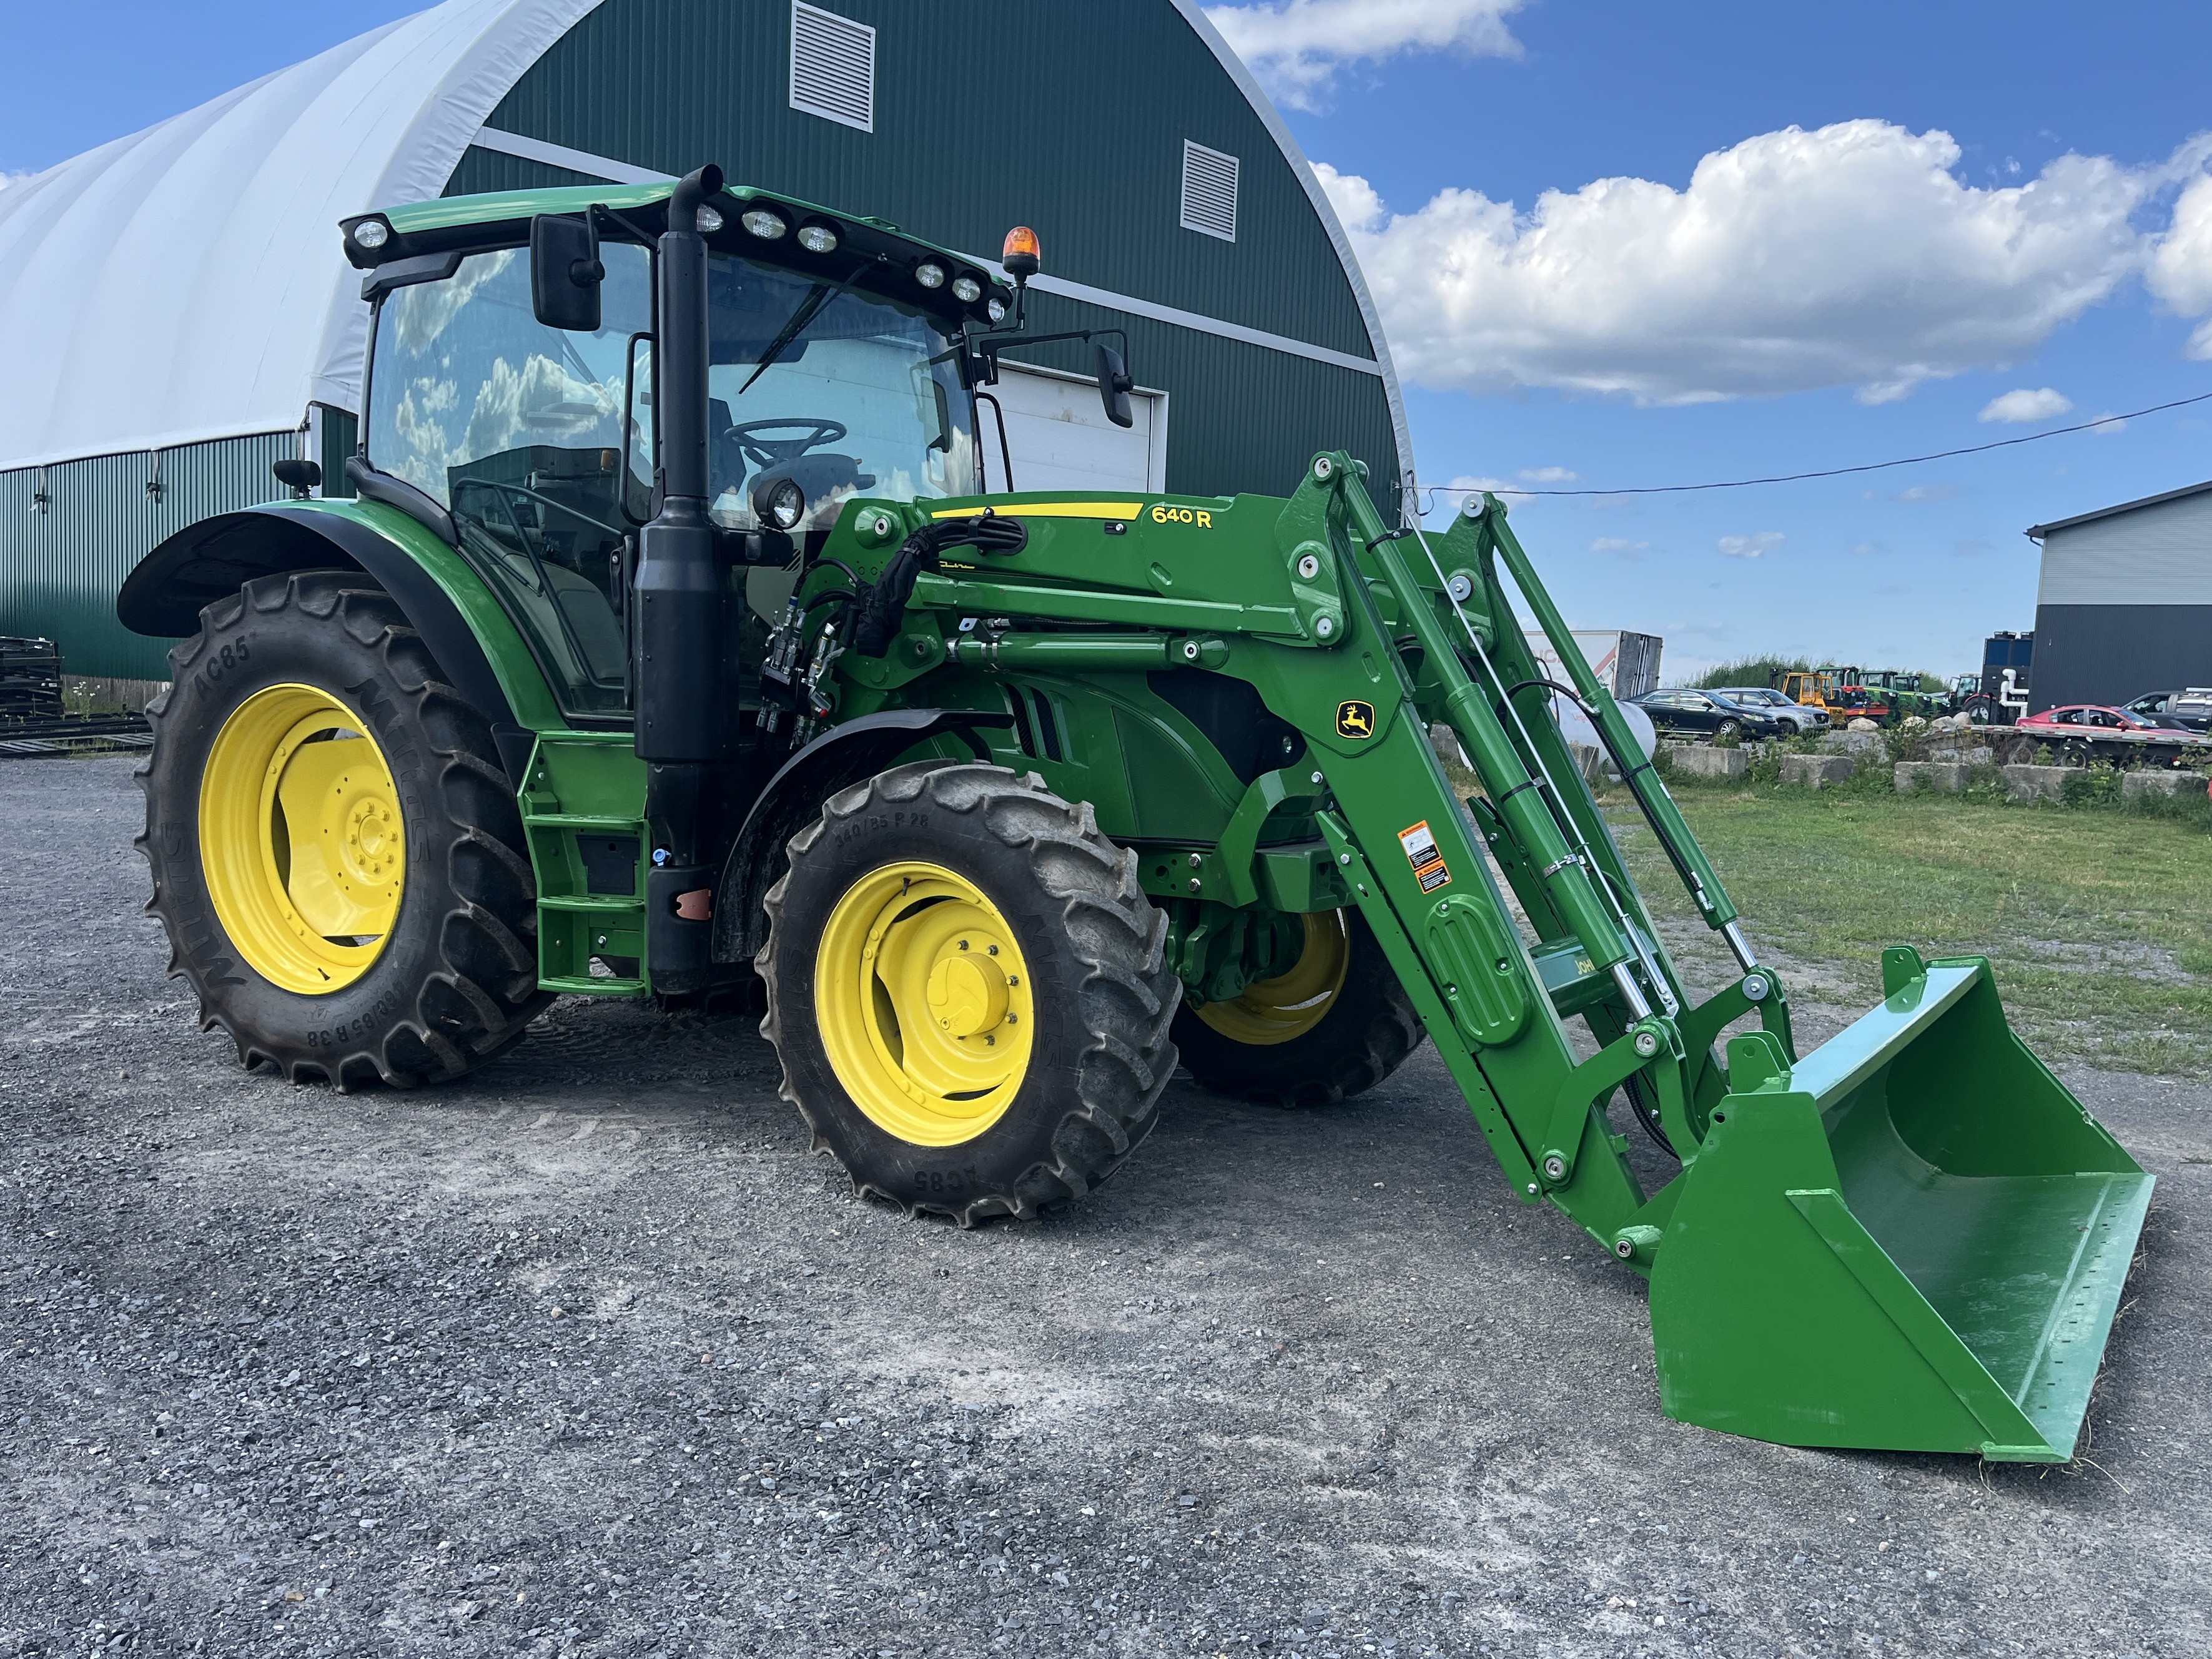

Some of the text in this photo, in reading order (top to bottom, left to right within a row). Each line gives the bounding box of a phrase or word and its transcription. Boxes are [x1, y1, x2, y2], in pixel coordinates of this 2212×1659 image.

[1152, 506, 1214, 529] 640 R
[194, 636, 250, 700] AC85
[911, 812, 929, 827] 28
[307, 1030, 332, 1047] 38
[337, 1025, 350, 1043] R
[914, 1164, 980, 1193] AC85
